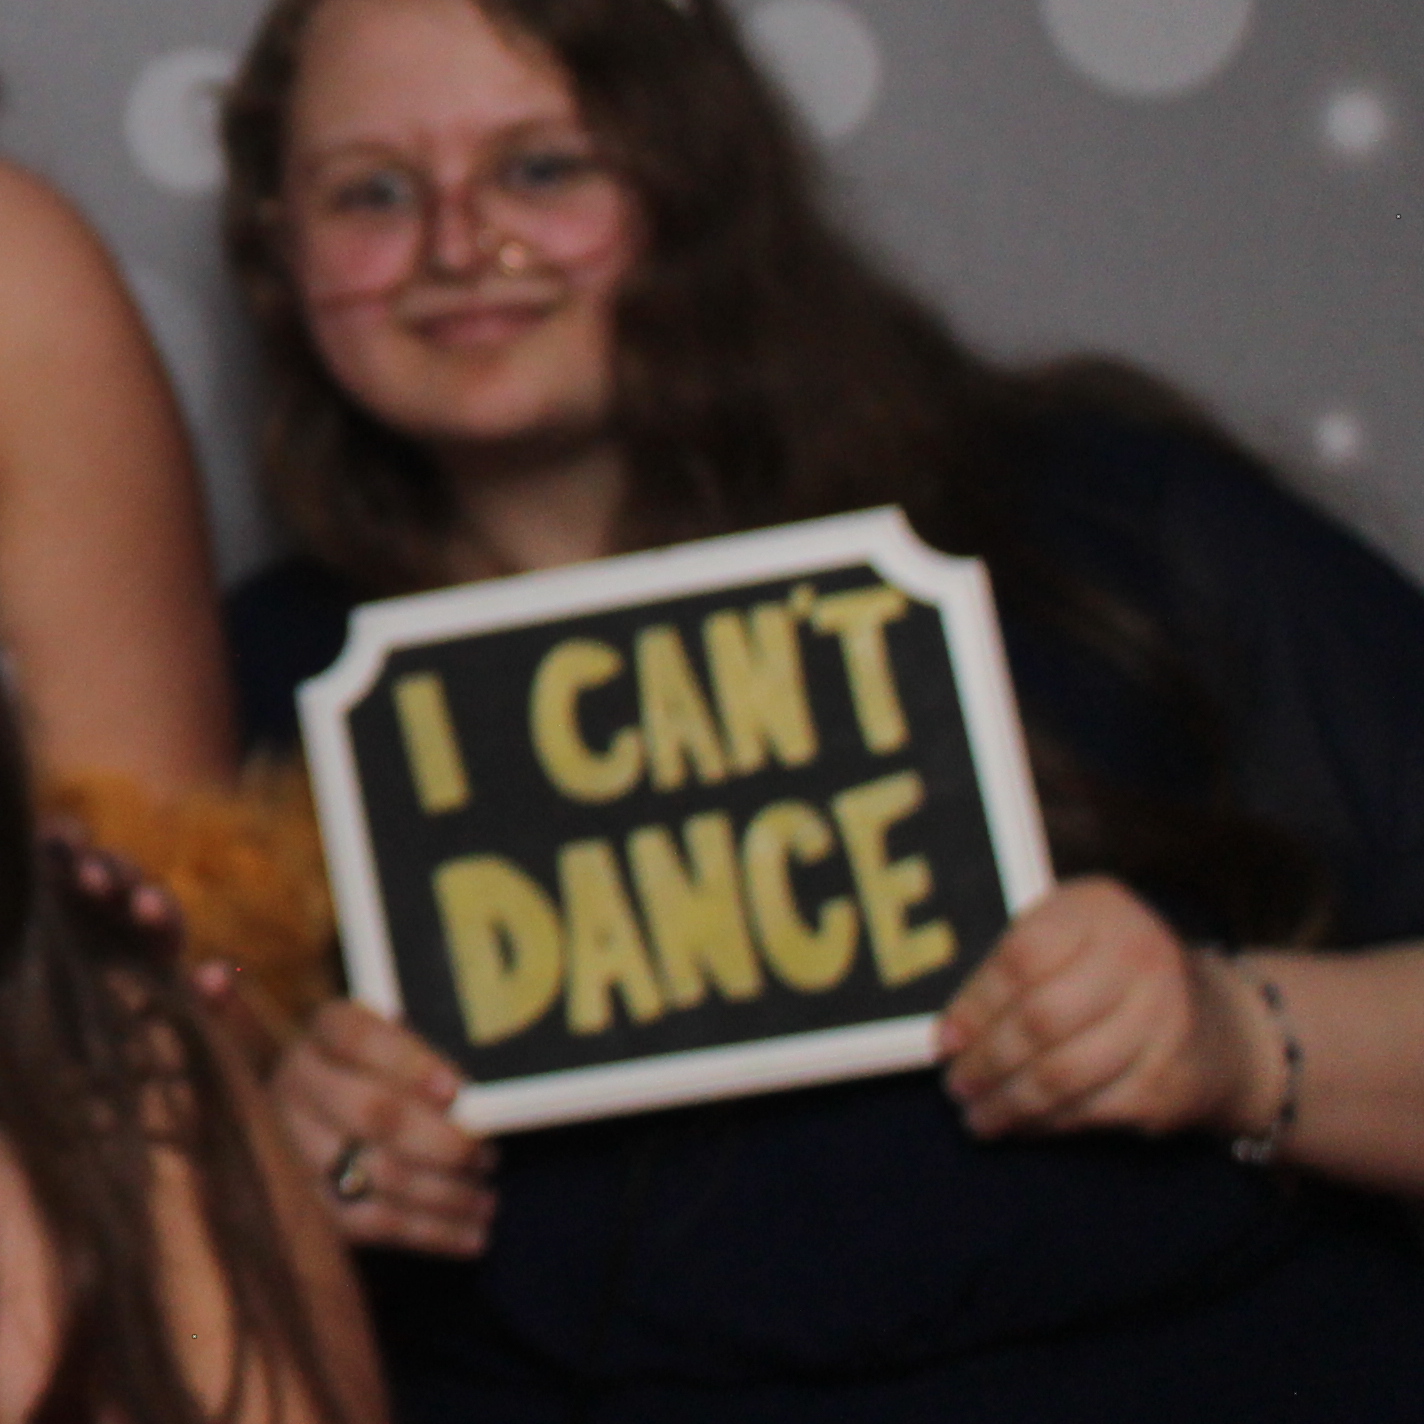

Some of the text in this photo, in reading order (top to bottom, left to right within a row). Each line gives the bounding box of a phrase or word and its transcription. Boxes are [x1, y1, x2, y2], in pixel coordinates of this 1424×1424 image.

[393, 583, 911, 815] I CAN'T
[432, 770, 957, 1047] DANCE
